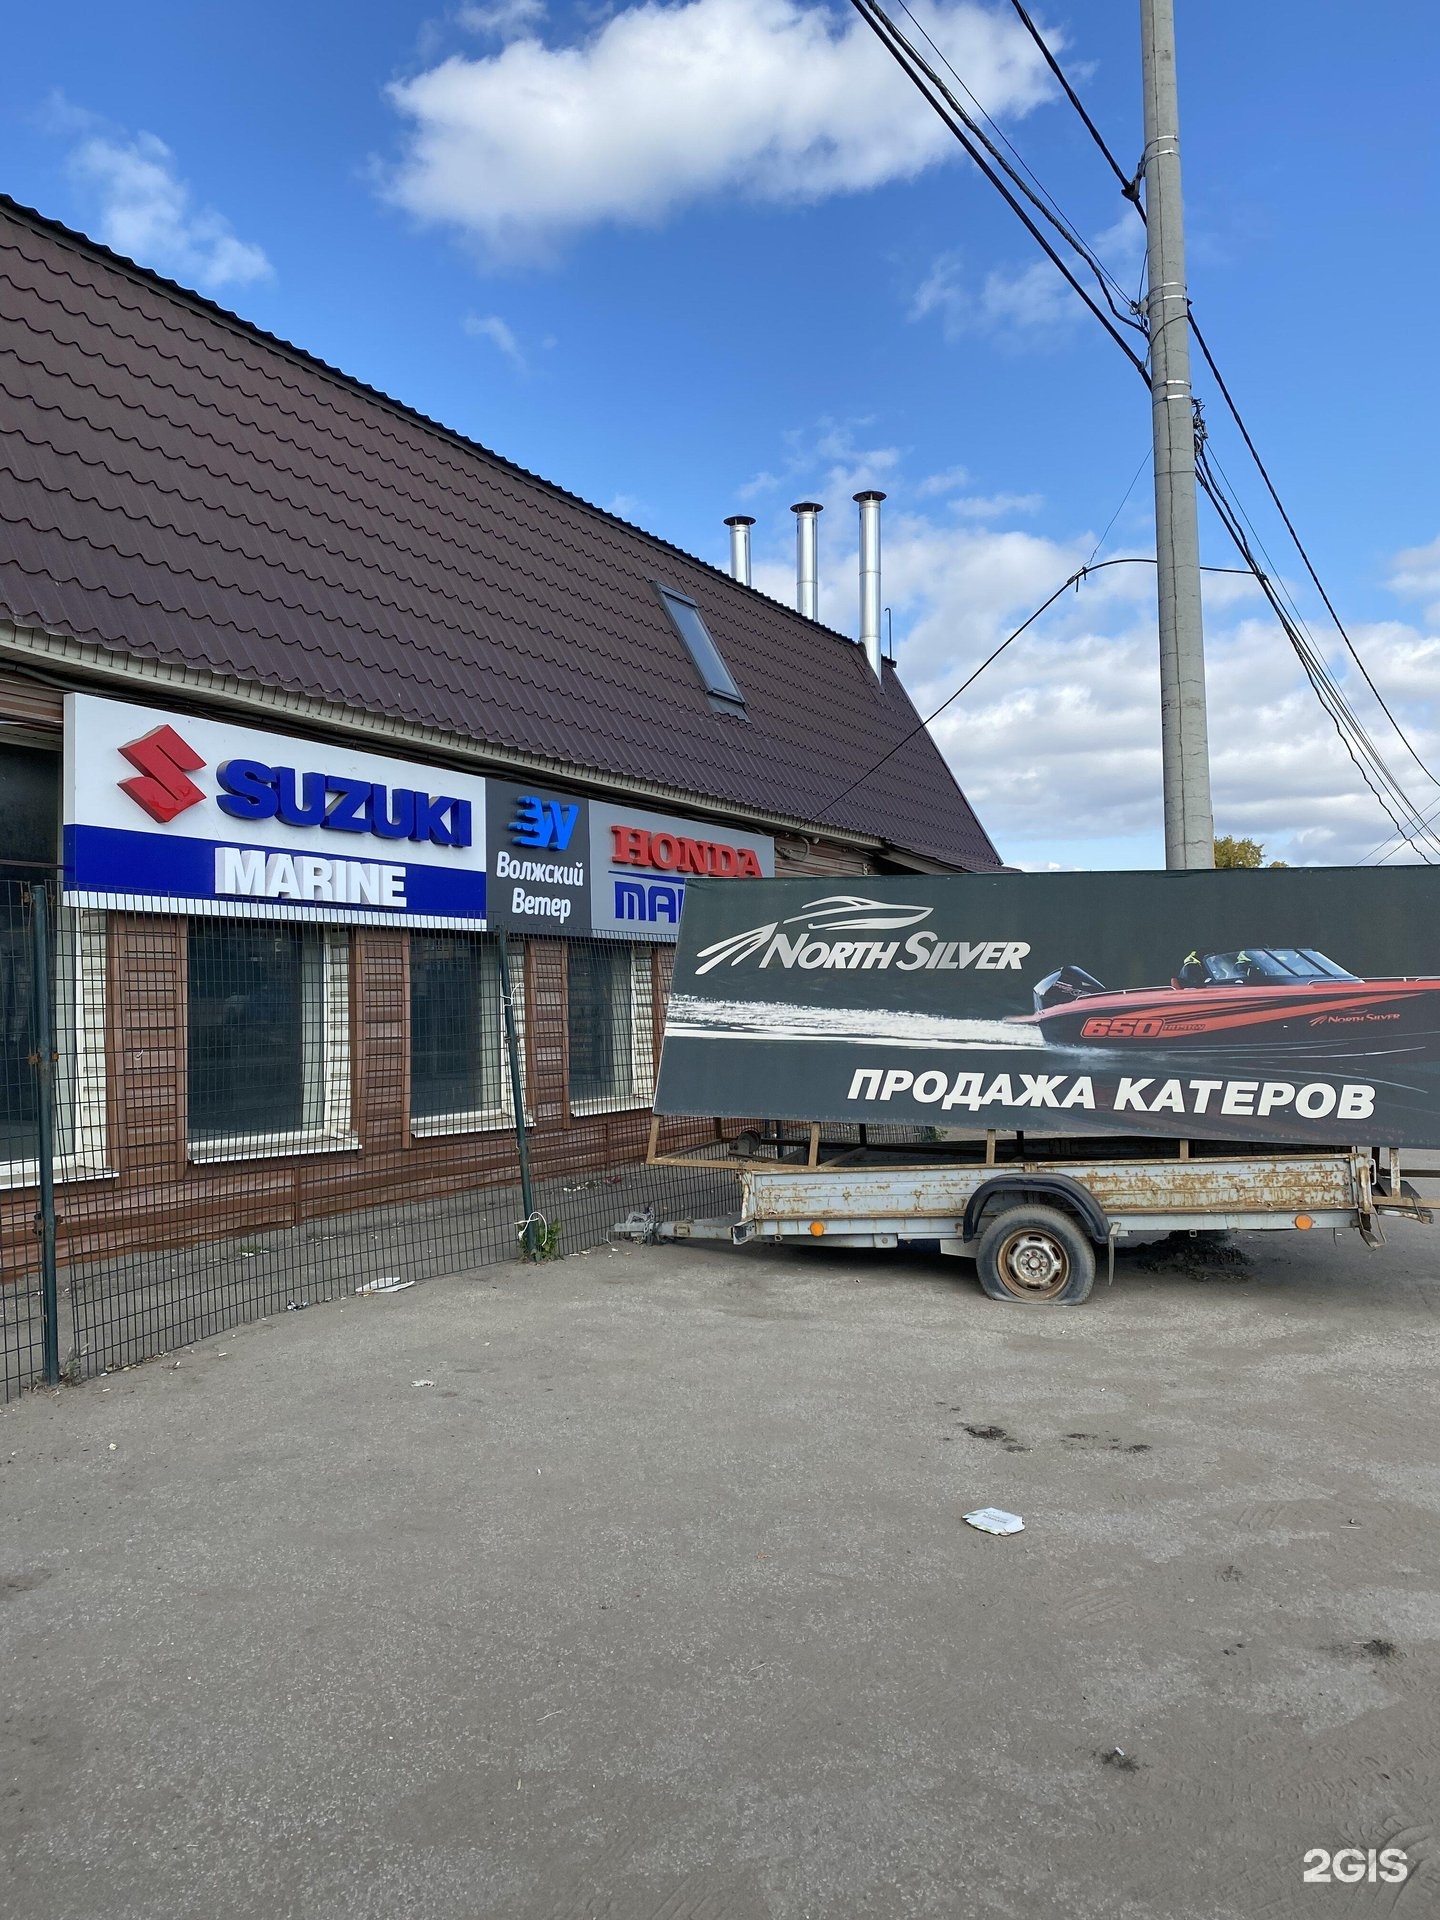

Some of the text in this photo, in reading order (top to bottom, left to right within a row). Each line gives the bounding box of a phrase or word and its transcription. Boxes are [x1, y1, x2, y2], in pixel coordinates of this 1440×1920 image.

[216, 759, 472, 847] SUZUKI
[496, 850, 584, 887] Волжский
[610, 825, 764, 878] HONDA
[214, 846, 407, 907] MARINE
[511, 888, 571, 924] Ветер
[615, 881, 684, 923] MA
[1082, 1018, 1164, 1038] 650
[847, 1069, 1376, 1120] ПРОДАЖА КАТЕРОВ
